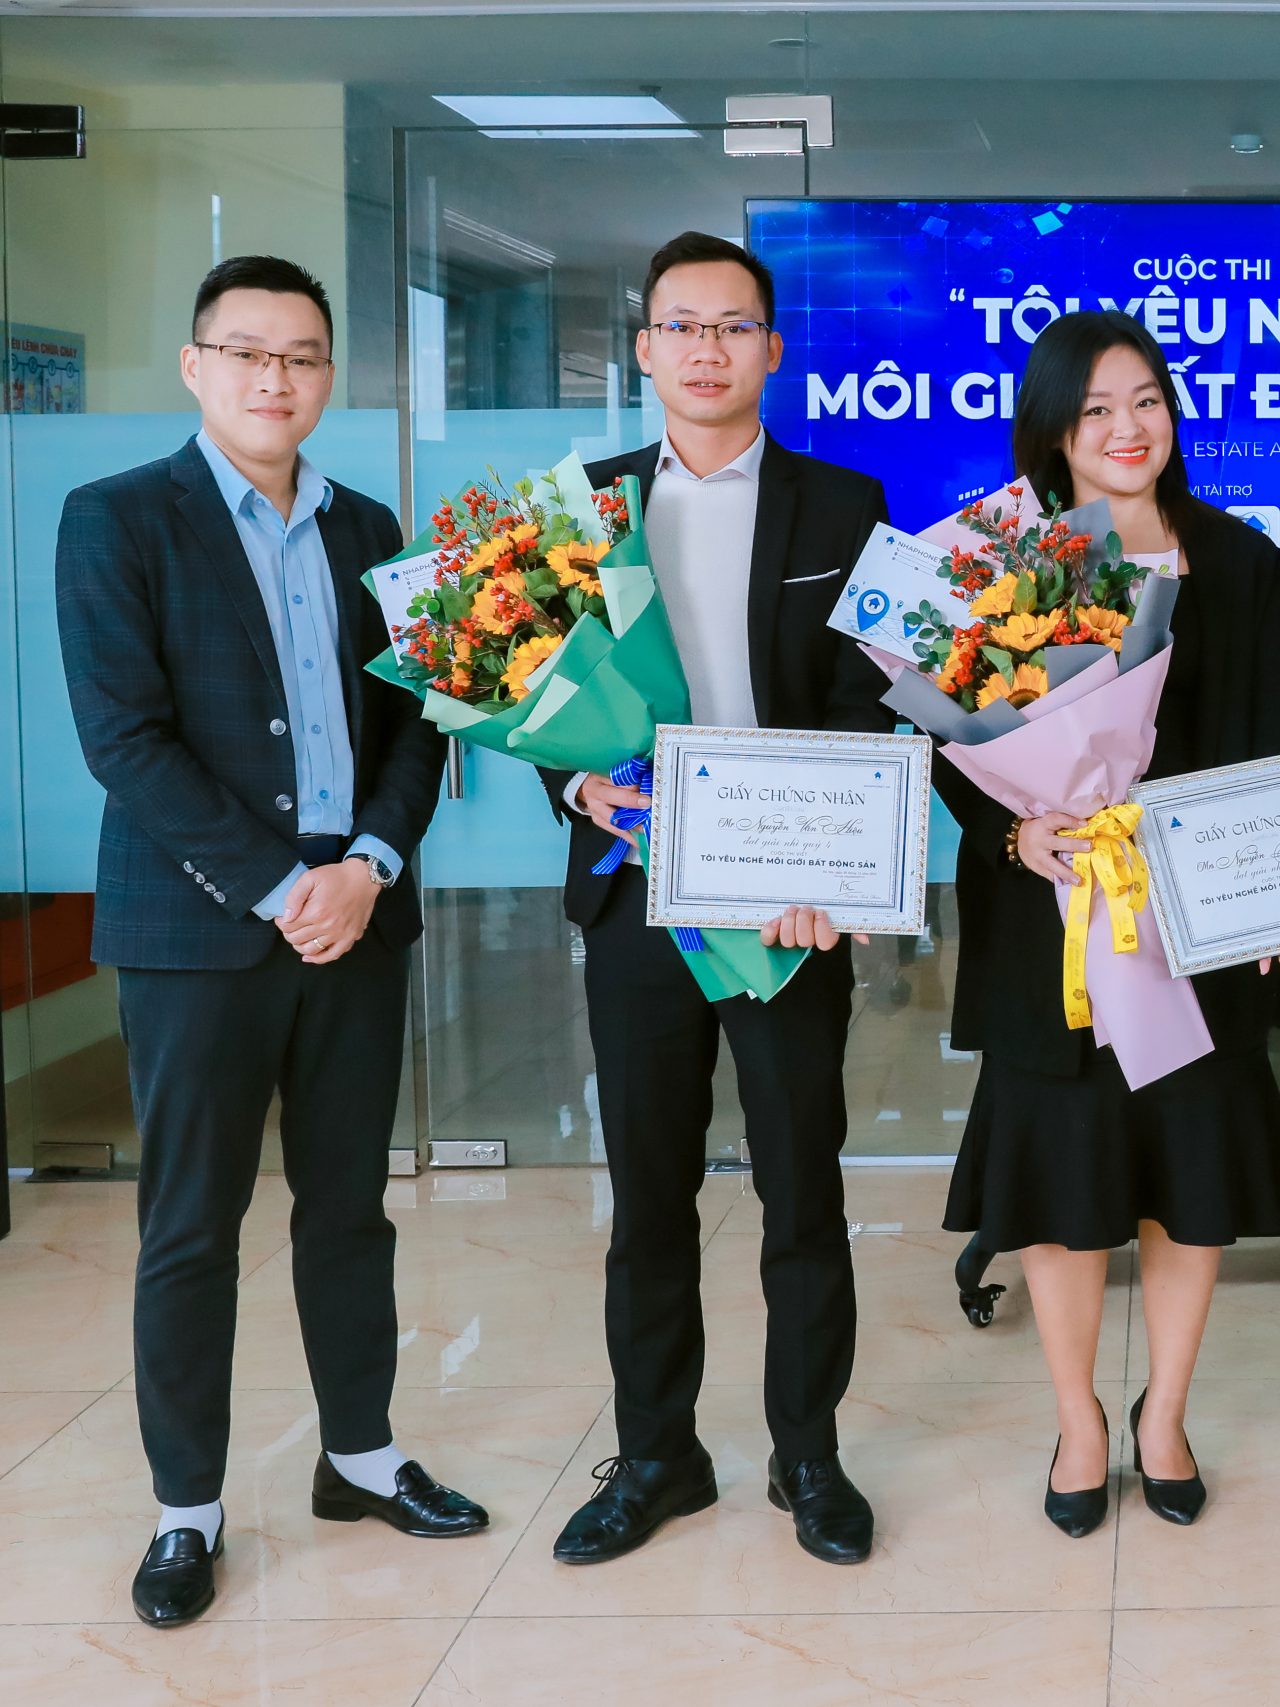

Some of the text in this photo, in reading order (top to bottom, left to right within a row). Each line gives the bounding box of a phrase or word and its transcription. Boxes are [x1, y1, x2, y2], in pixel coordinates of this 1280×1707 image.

[1133, 254, 1271, 286] CUỘC THI
[949, 284, 1080, 344] “TÔ
[807, 360, 931, 420] MÔI
[950, 372, 1014, 420] GI
[1194, 441, 1263, 457] ESTATE
[1203, 483, 1222, 496] TÀI
[1225, 483, 1253, 499] TRỢ
[897, 540, 942, 565] NHAPHONET
[402, 562, 439, 577] NHAPHO
[717, 781, 865, 806] GIẤY CHỨNG NHẬN
[1194, 822, 1226, 843] GIẤY
[700, 853, 876, 869] TÔI YÊU NGHỀ MÔI GIỚI BẤT ĐỘNG SẢN
[1200, 897, 1214, 906] TÔI
[1216, 892, 1233, 902] YÊU
[1235, 885, 1259, 898] NGHỀ
[1260, 882, 1277, 892] MÔI
